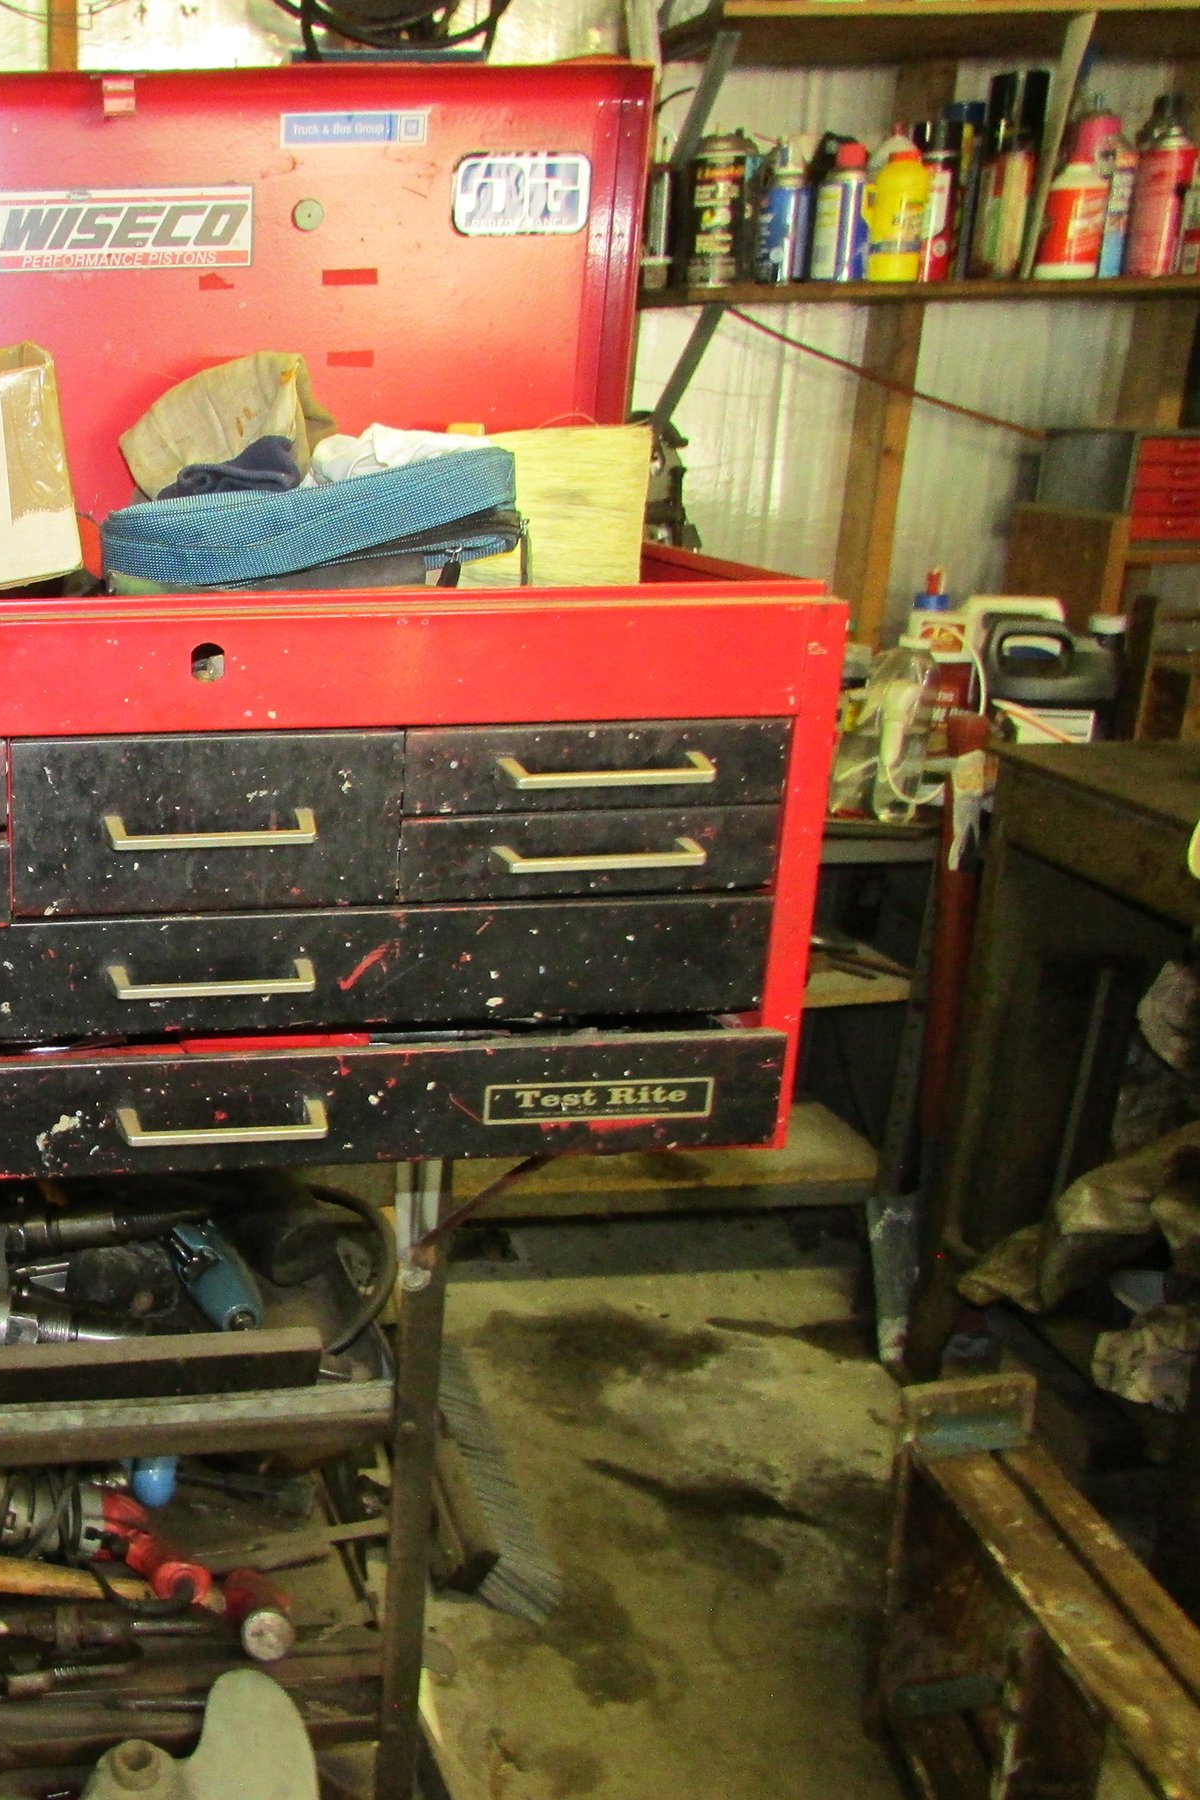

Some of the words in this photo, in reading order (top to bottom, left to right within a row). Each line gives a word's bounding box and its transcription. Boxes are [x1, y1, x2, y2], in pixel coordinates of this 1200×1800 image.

[293, 123, 320, 136] Truck
[322, 124, 330, 136] &
[332, 122, 352, 136] Bus
[354, 122, 385, 137] Group
[0, 204, 250, 250] WISECO
[22, 252, 144, 268] PERFORMANCE
[149, 251, 217, 265] PISTONS
[514, 1088, 598, 1109] Test
[606, 1085, 688, 1105] Rite
